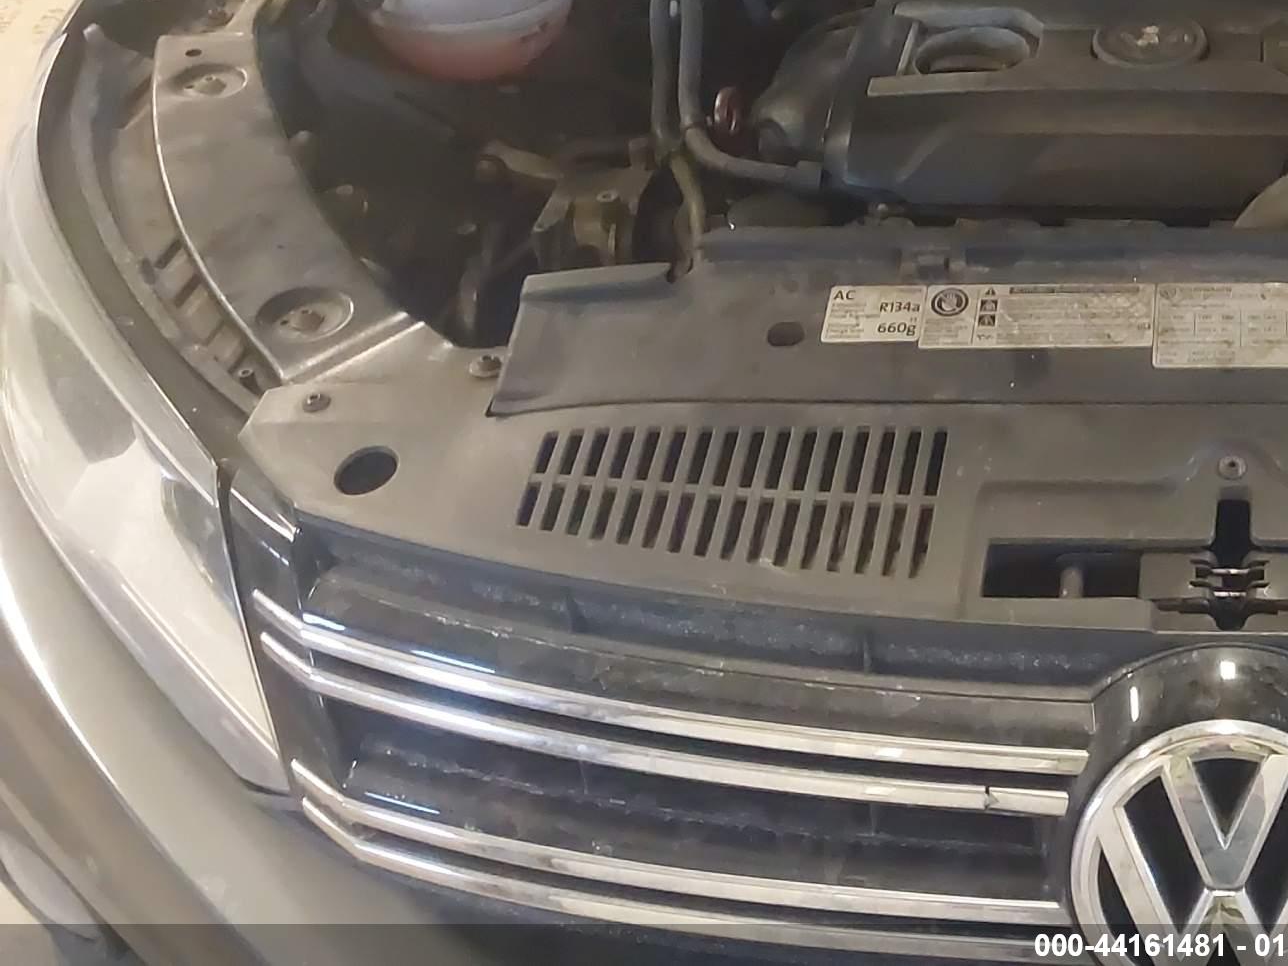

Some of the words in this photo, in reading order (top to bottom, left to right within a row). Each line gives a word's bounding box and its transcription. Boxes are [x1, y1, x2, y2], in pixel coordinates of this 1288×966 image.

[833, 290, 856, 301] AC
[879, 301, 921, 313] R134a
[877, 322, 916, 336] 660g
